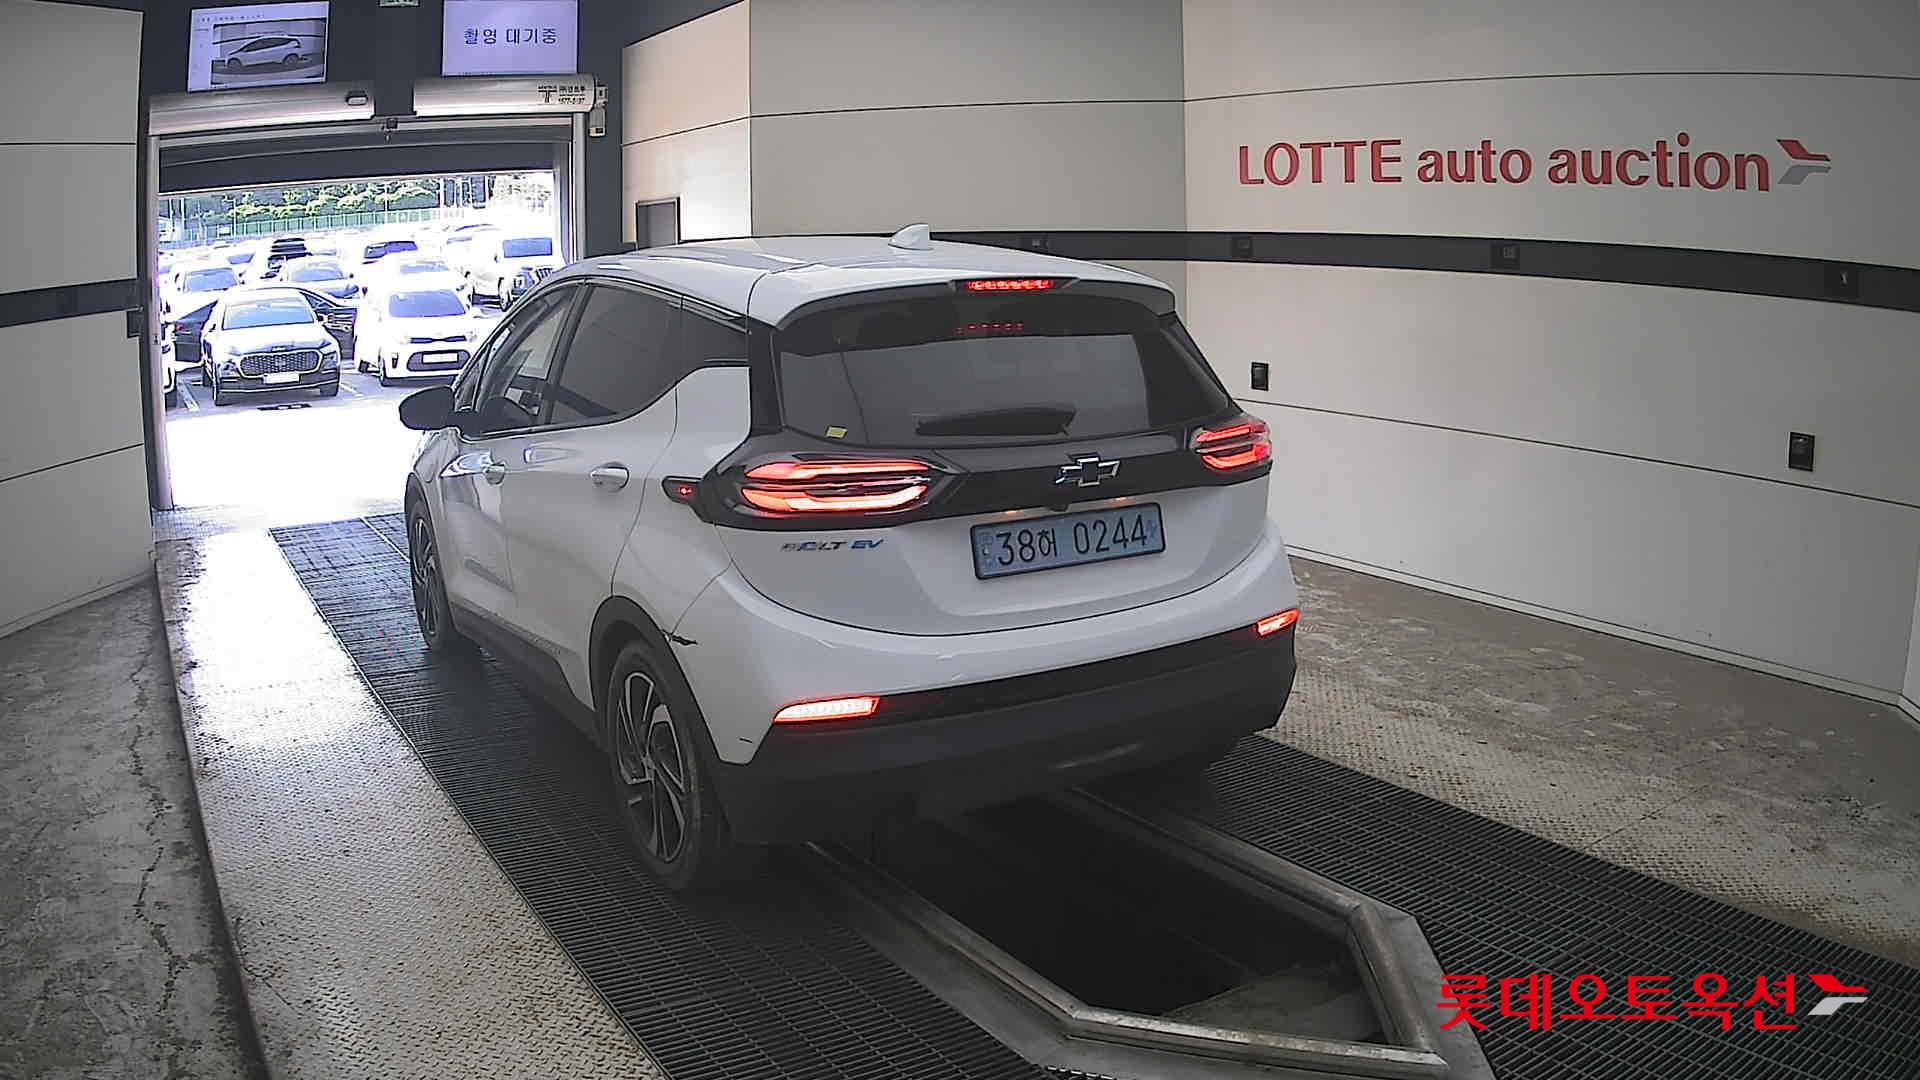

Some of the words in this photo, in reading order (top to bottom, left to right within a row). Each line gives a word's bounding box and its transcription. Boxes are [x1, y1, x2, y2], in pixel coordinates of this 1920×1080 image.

[506, 28, 557, 44] 대기중
[1239, 139, 1402, 185] LOTTE
[1417, 140, 1532, 183] auto
[1548, 132, 1769, 192] auction
[850, 539, 884, 549] EV
[996, 528, 1058, 566] 38허
[1072, 514, 1147, 554] 0244
